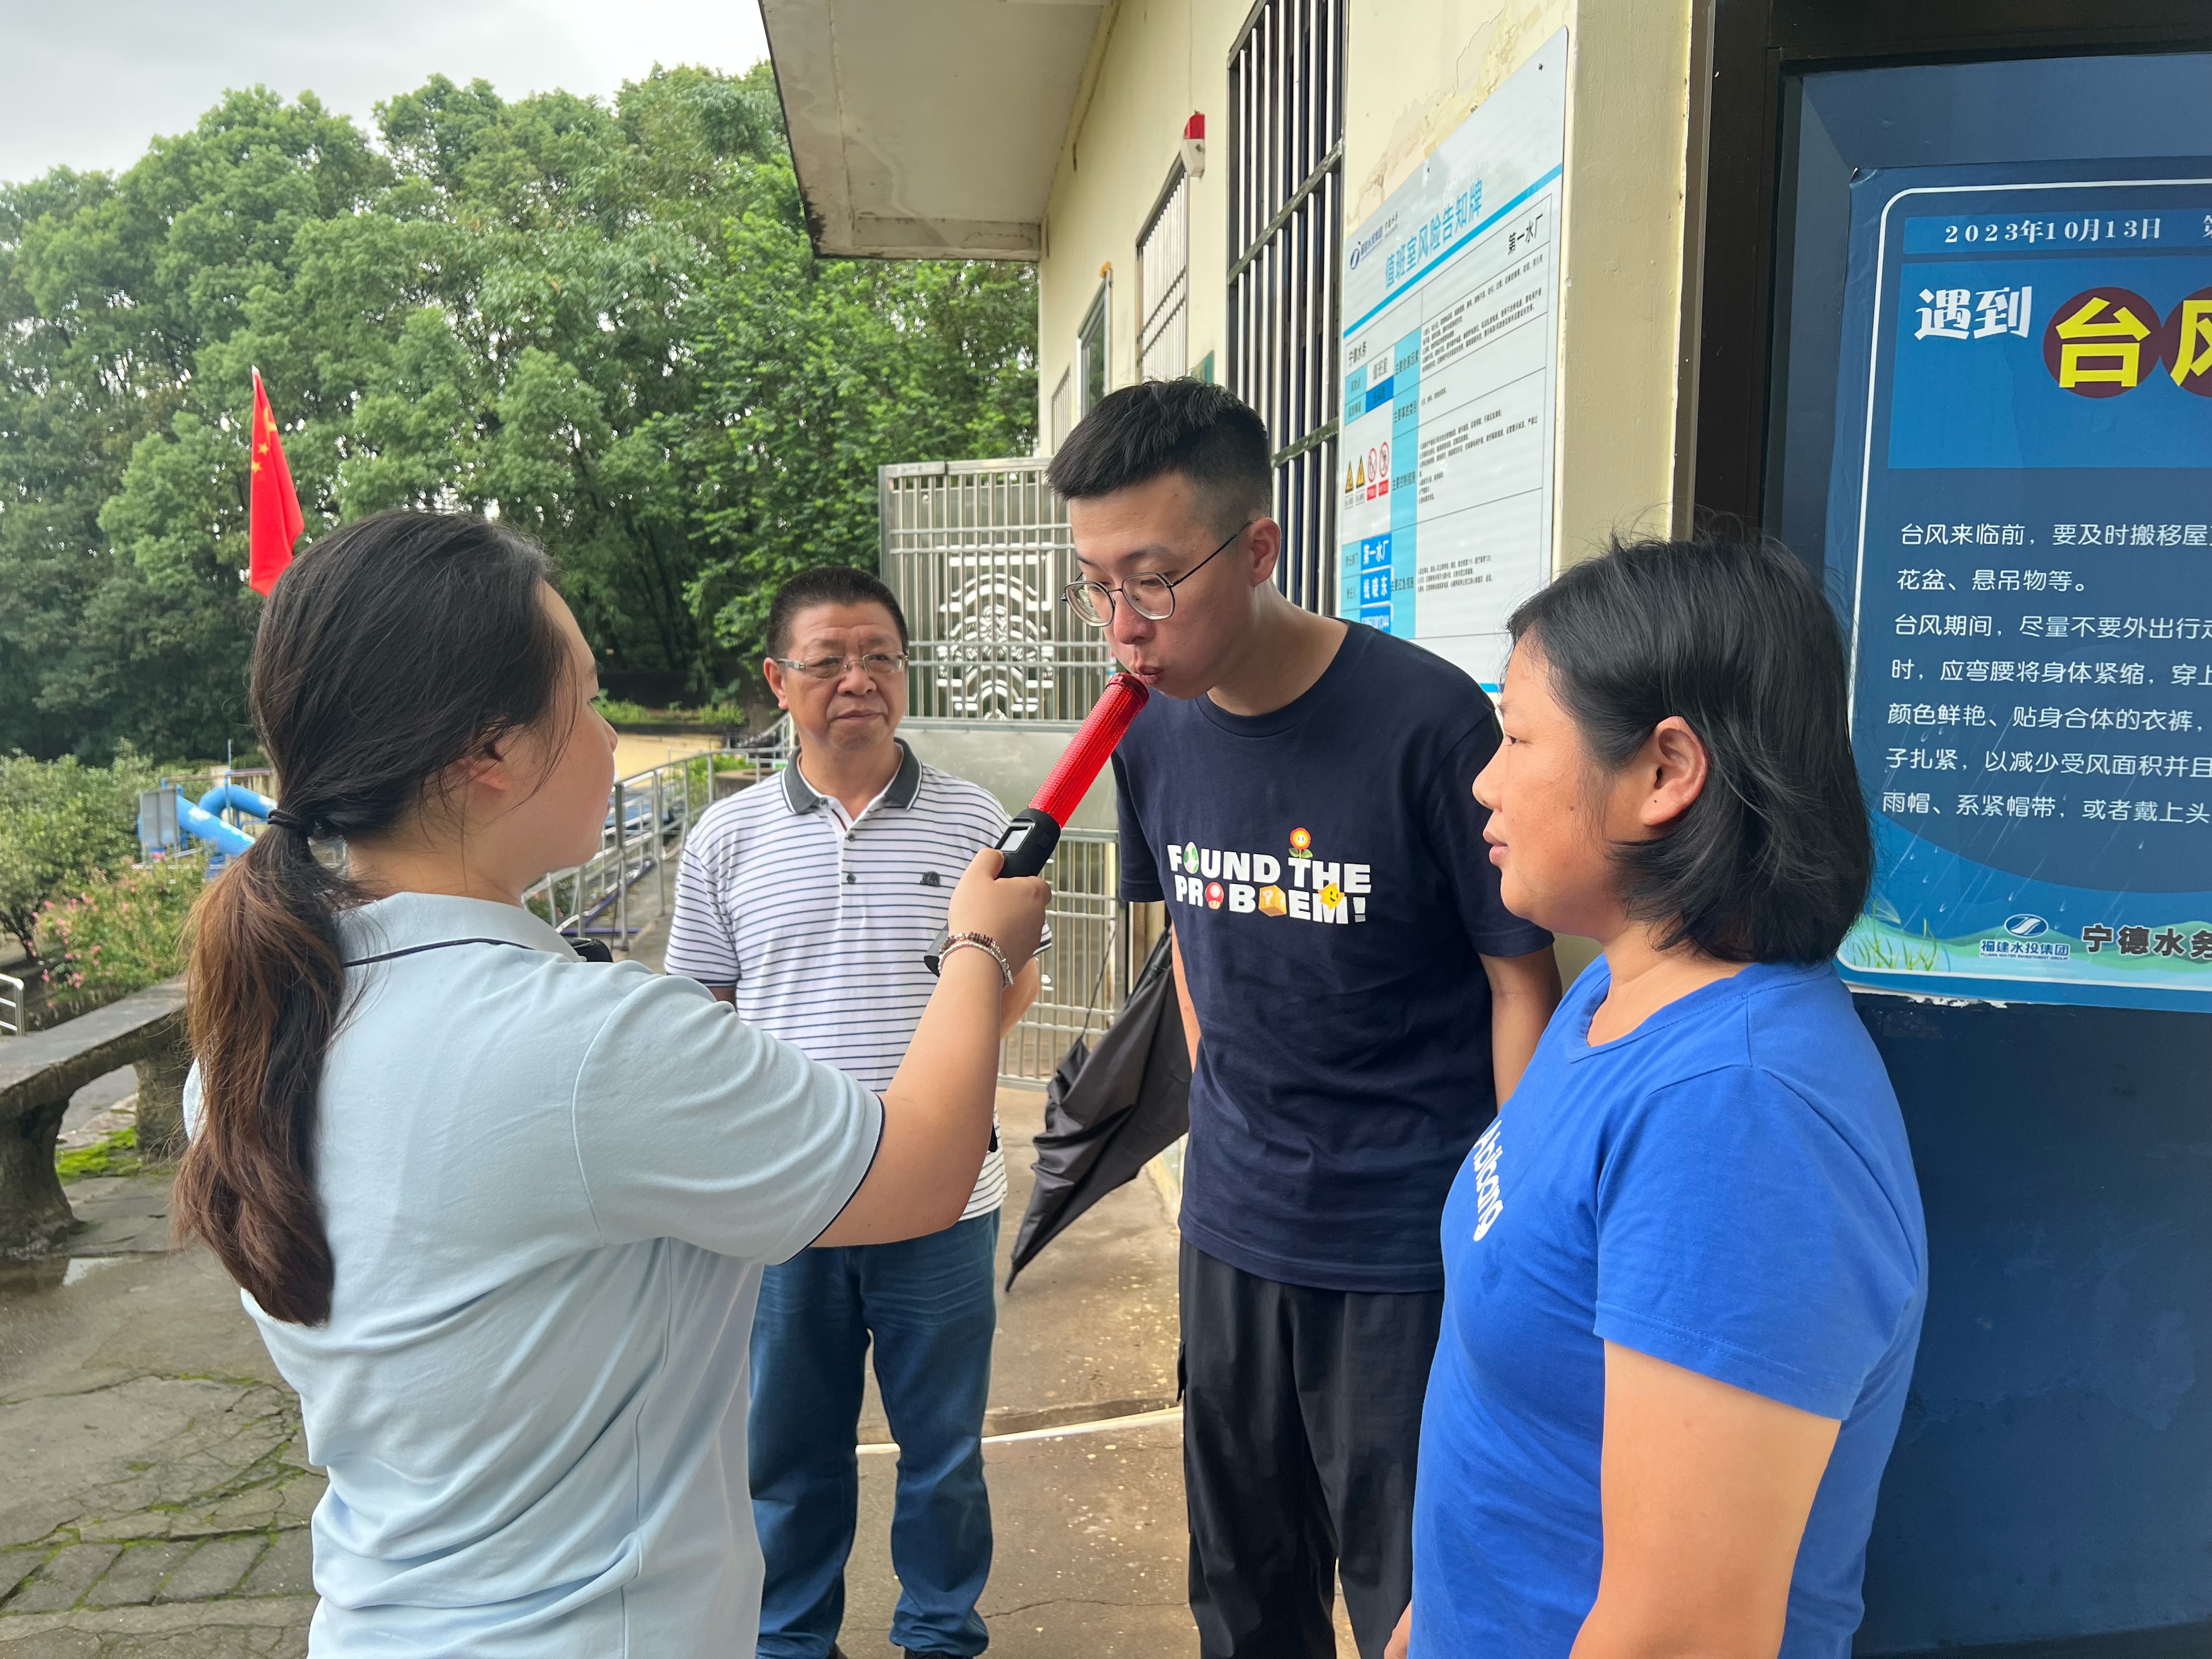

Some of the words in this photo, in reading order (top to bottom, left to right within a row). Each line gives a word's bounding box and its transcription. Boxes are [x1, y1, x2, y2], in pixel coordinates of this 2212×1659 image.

[1385, 177, 1483, 290] 值班室风险告知牌
[1508, 213, 1544, 256] 第一水厂
[1944, 217, 2161, 244] 2023年10月13日
[1914, 285, 2033, 341] 遇到
[1901, 523, 2212, 546] 台风来临前，要及时搬移屋
[1363, 540, 1389, 565] 第一水厂
[1897, 568, 2085, 592] 花盆、悬吊物等。
[1887, 702, 2203, 732] 颜色鲜艳、贴身合体的衣裤，
[1886, 748, 2212, 778] 子扎紧，以减少受风面积并且
[1882, 791, 2210, 824] 雨帽、系紧帽带，或者戴上头
[1166, 842, 1281, 883] FUND
[1288, 856, 1372, 894] THE
[1981, 940, 2069, 956] 福建水投集团
[2083, 924, 2212, 959] 宁德水务
